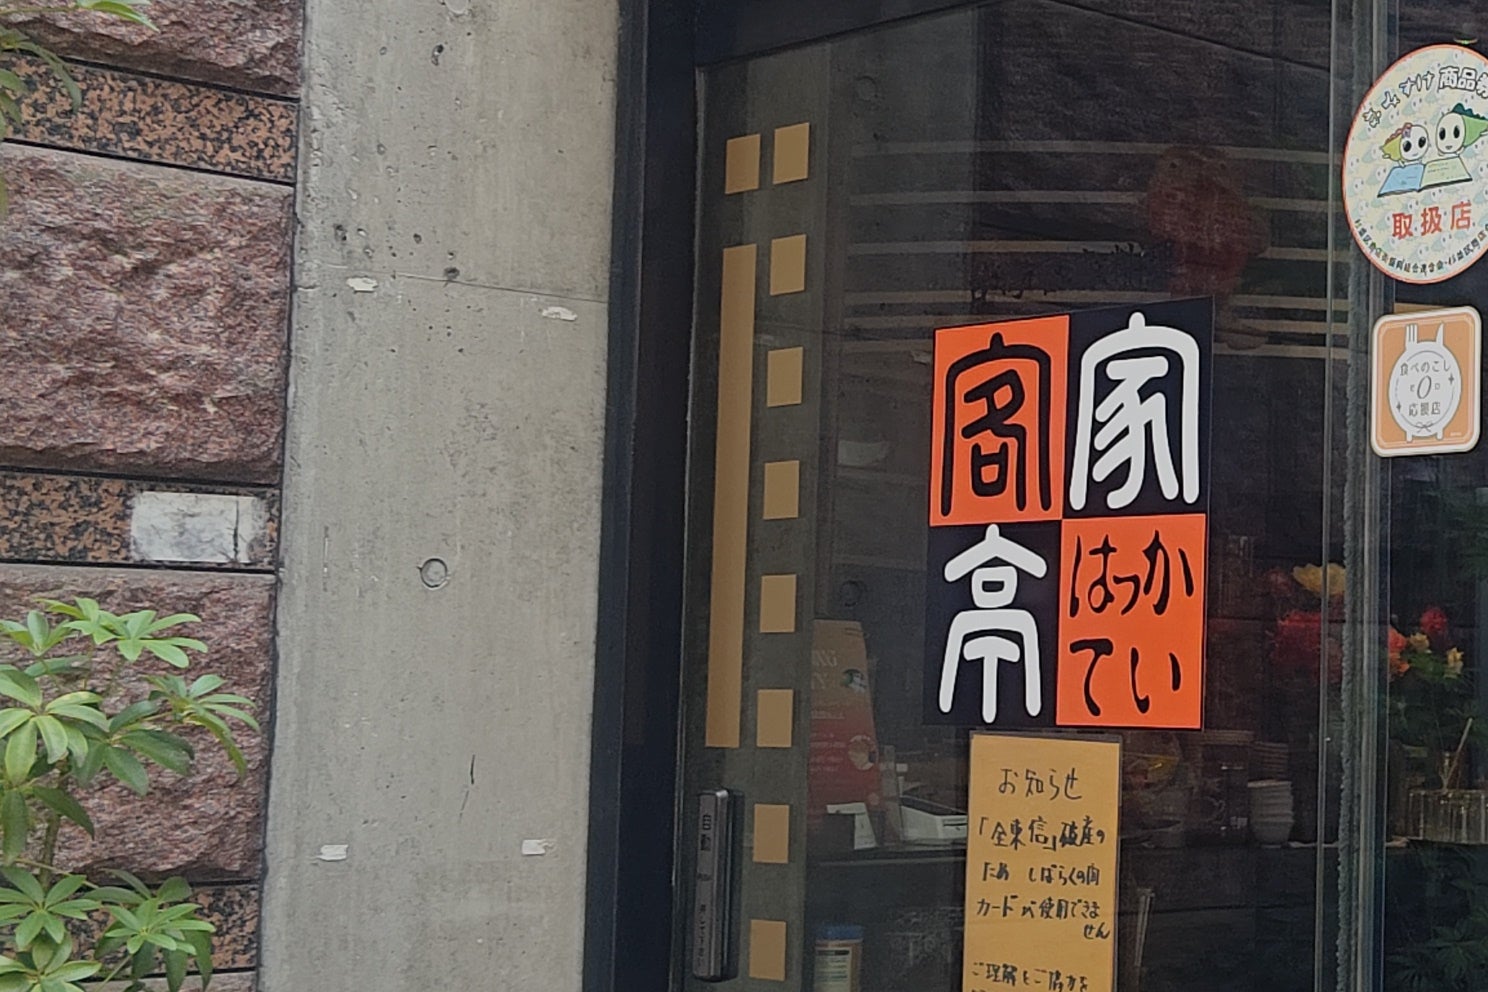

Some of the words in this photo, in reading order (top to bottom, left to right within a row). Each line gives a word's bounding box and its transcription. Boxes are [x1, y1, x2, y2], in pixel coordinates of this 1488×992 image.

[1391, 200, 1473, 240] 取扱店
[1400, 360, 1451, 377] 食べのこし
[1069, 530, 1195, 618] はっか
[938, 523, 1048, 724] 亭
[1069, 637, 1181, 717] てい
[998, 767, 1083, 801] お知らせ
[1083, 922, 1111, 940] せん
